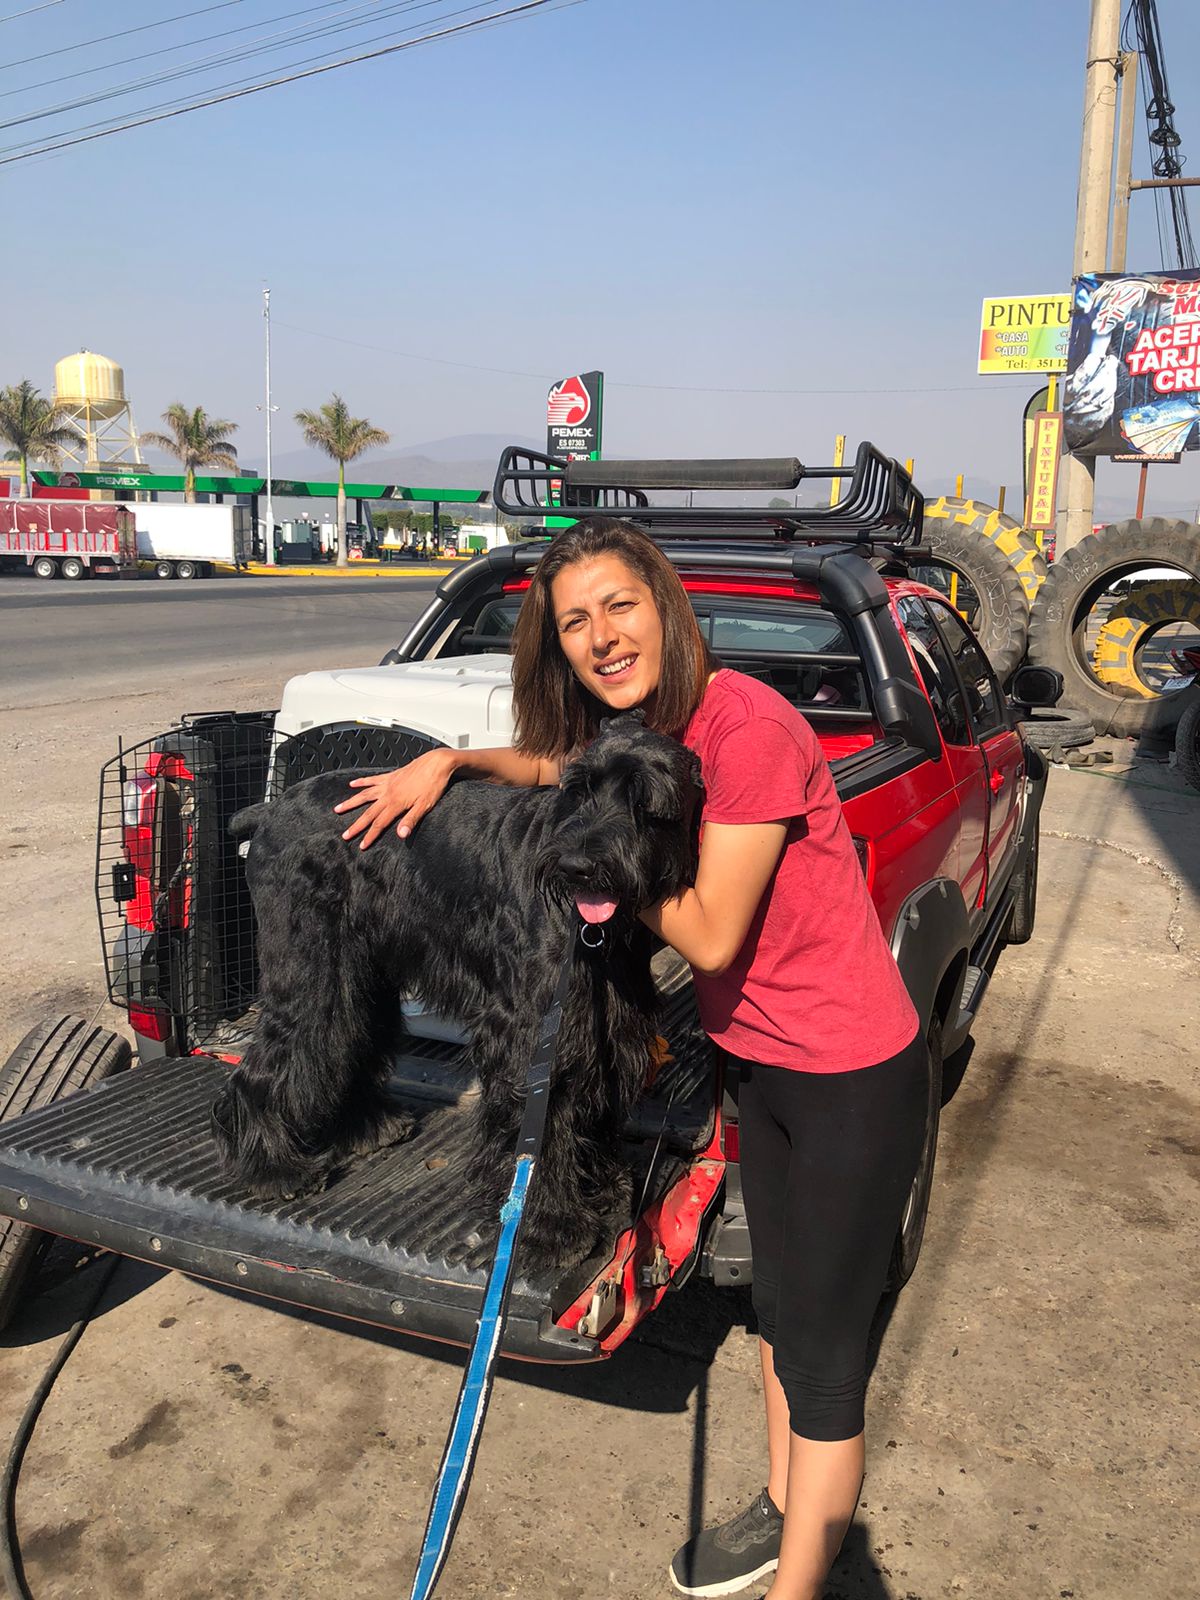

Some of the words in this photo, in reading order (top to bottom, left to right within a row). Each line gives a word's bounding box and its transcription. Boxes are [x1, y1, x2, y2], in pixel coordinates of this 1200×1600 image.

[1172, 296, 1200, 315] M
[989, 302, 1072, 327] PINTU
[1002, 331, 1029, 343] CASA
[1002, 344, 1028, 356] AUTO
[1006, 359, 1028, 369] Tel:
[1037, 359, 1053, 368] 351
[1128, 345, 1200, 373] TARJ
[1156, 367, 1200, 391] CR
[552, 427, 593, 437] PEMEX
[1035, 420, 1054, 521] PINTURAS
[96, 476, 141, 486] PEMEX
